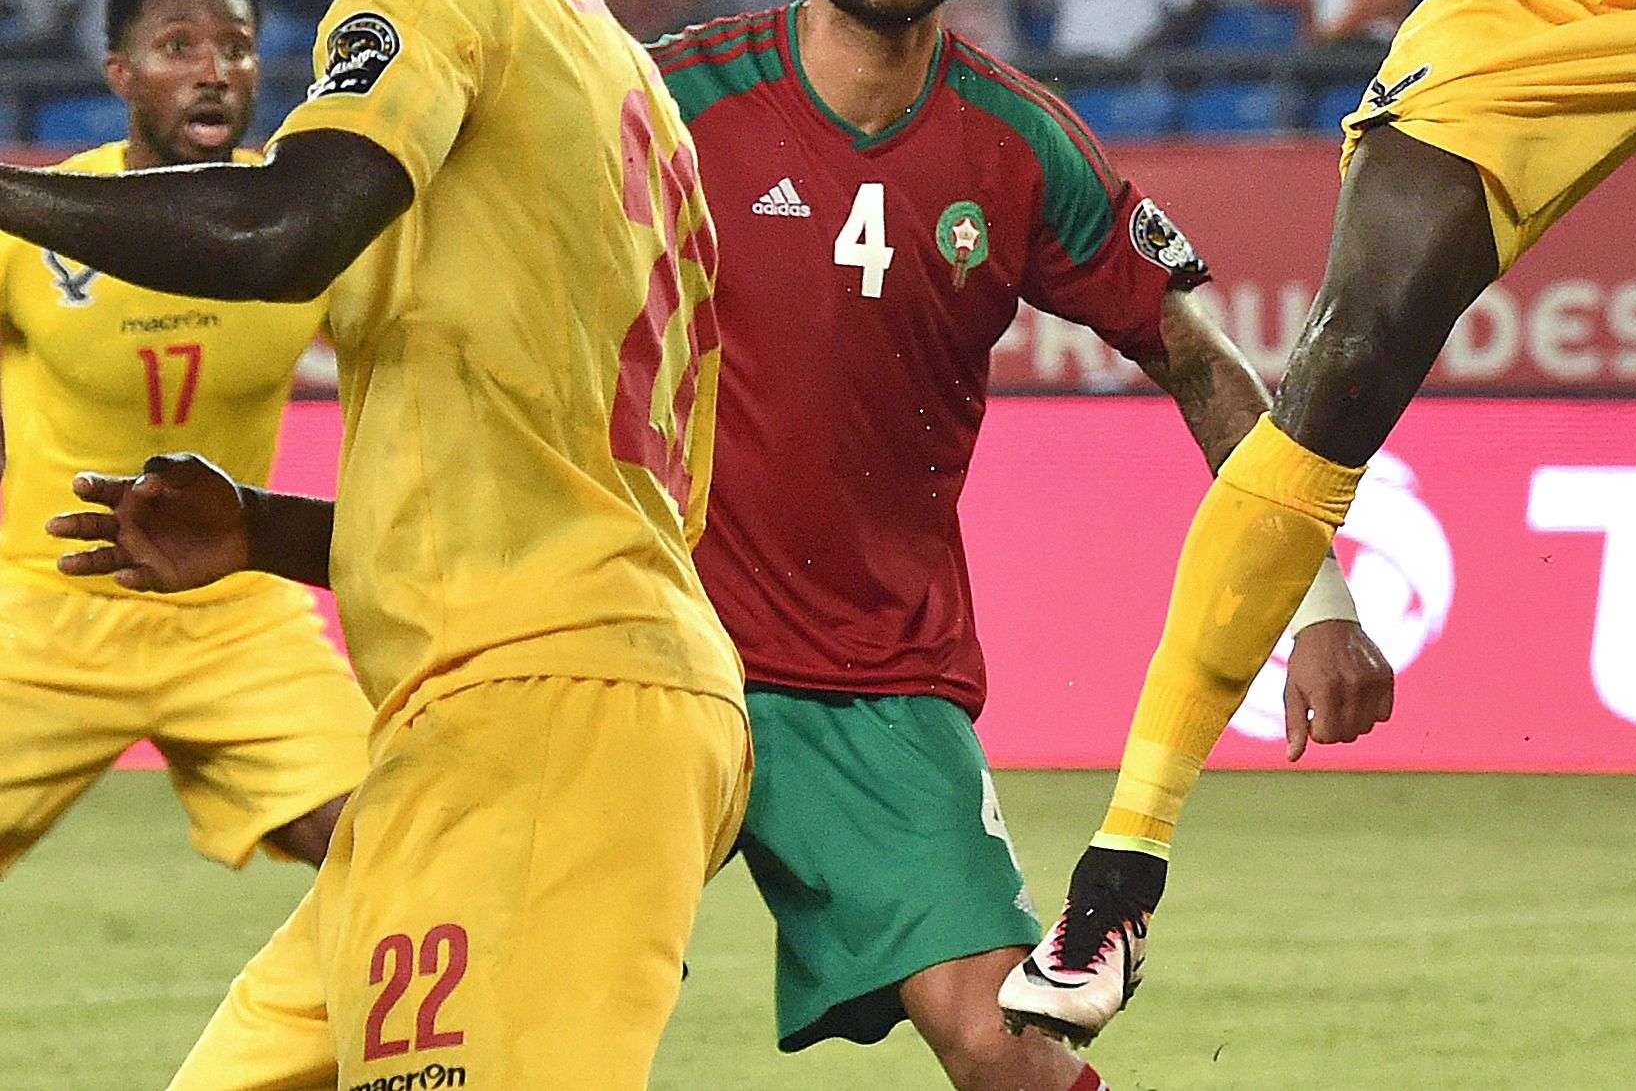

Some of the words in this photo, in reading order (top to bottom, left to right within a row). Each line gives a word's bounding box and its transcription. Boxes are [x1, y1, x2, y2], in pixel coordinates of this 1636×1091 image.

[751, 202, 812, 218] adidas
[834, 182, 895, 299] 4
[138, 344, 202, 426] 17
[364, 922, 469, 1062] 22
